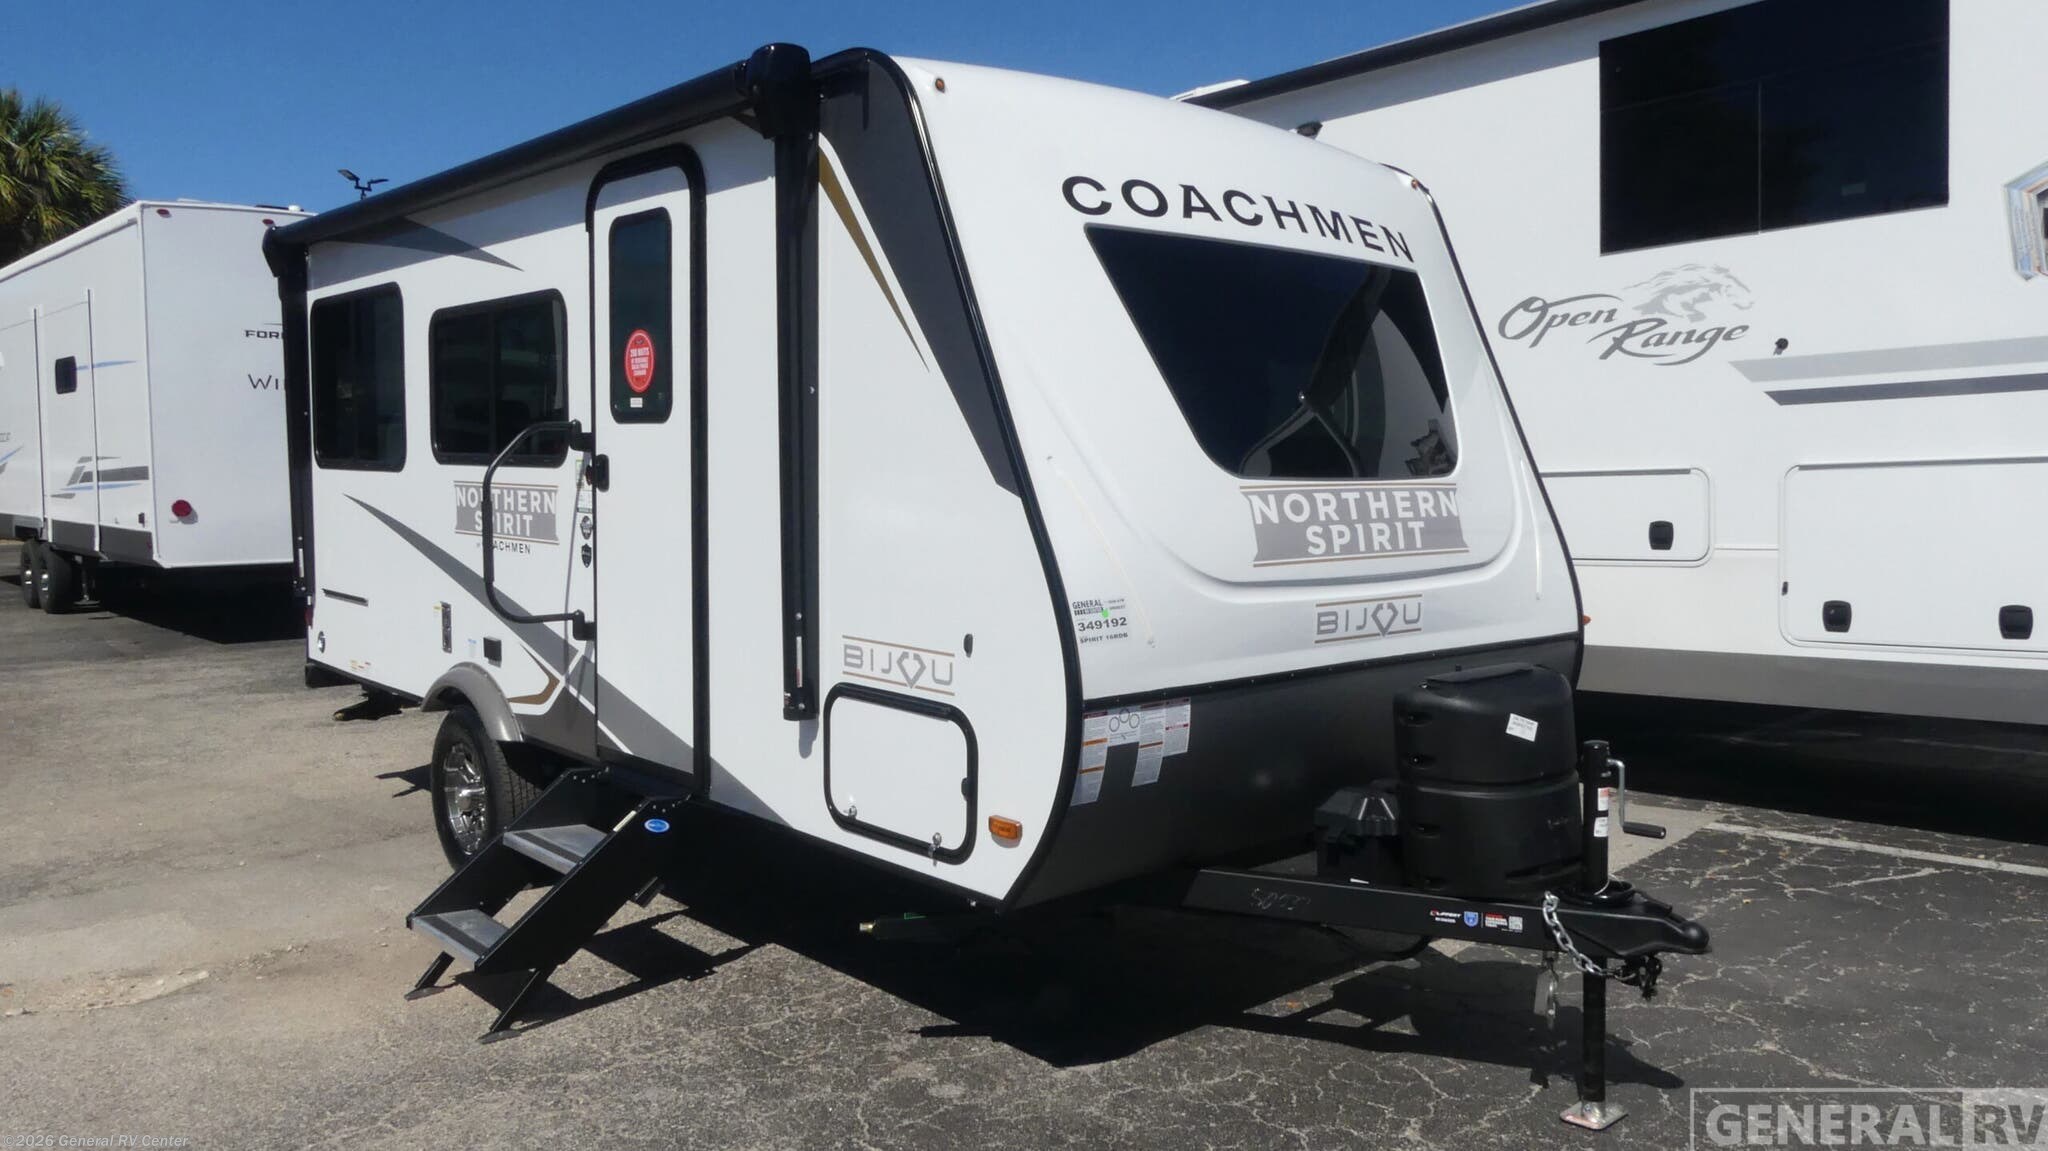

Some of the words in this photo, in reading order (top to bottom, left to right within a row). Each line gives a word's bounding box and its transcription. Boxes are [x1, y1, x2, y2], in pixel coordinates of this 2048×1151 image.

[1061, 175, 1415, 263] COACHMEN
[244, 329, 281, 339] FOR
[1498, 293, 1624, 349] Open
[1586, 317, 1750, 366] Range
[456, 486, 557, 515] NOTHERN
[1247, 489, 1460, 526] NORTHERN
[474, 510, 534, 537] SIRIT
[1305, 520, 1426, 556] SPIRIT
[1072, 600, 1103, 609] GENERAL
[1316, 601, 1422, 638] BIJOU
[1077, 616, 1128, 632] 349192
[843, 644, 953, 688] BIJOU
